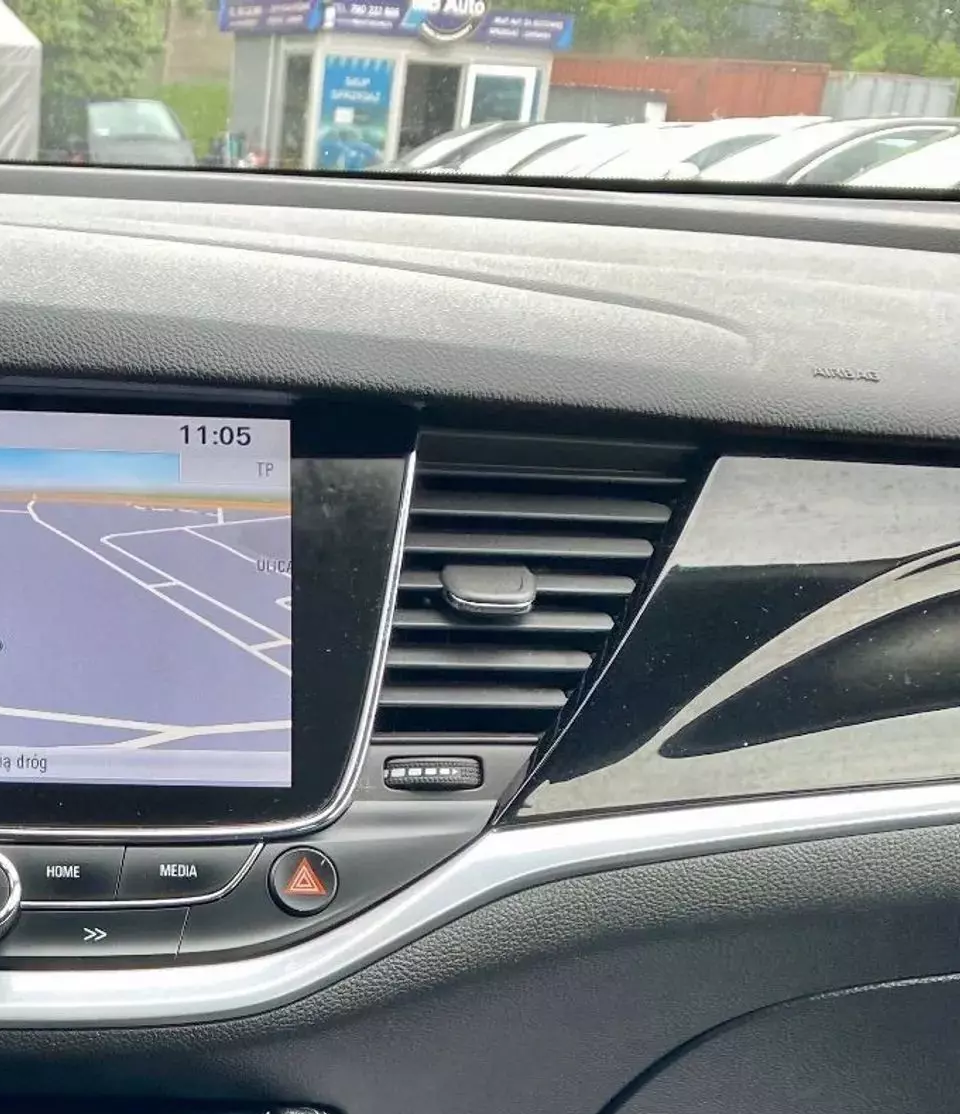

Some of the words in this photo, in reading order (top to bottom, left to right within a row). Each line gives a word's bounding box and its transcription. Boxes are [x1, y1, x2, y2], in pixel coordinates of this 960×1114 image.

[813, 367, 880, 383] AIRBAG
[180, 424, 252, 447] 11:05
[256, 461, 274, 477] TP
[16, 752, 47, 774] dróg
[46, 864, 81, 880] HOME
[159, 863, 198, 879] MEDIA
